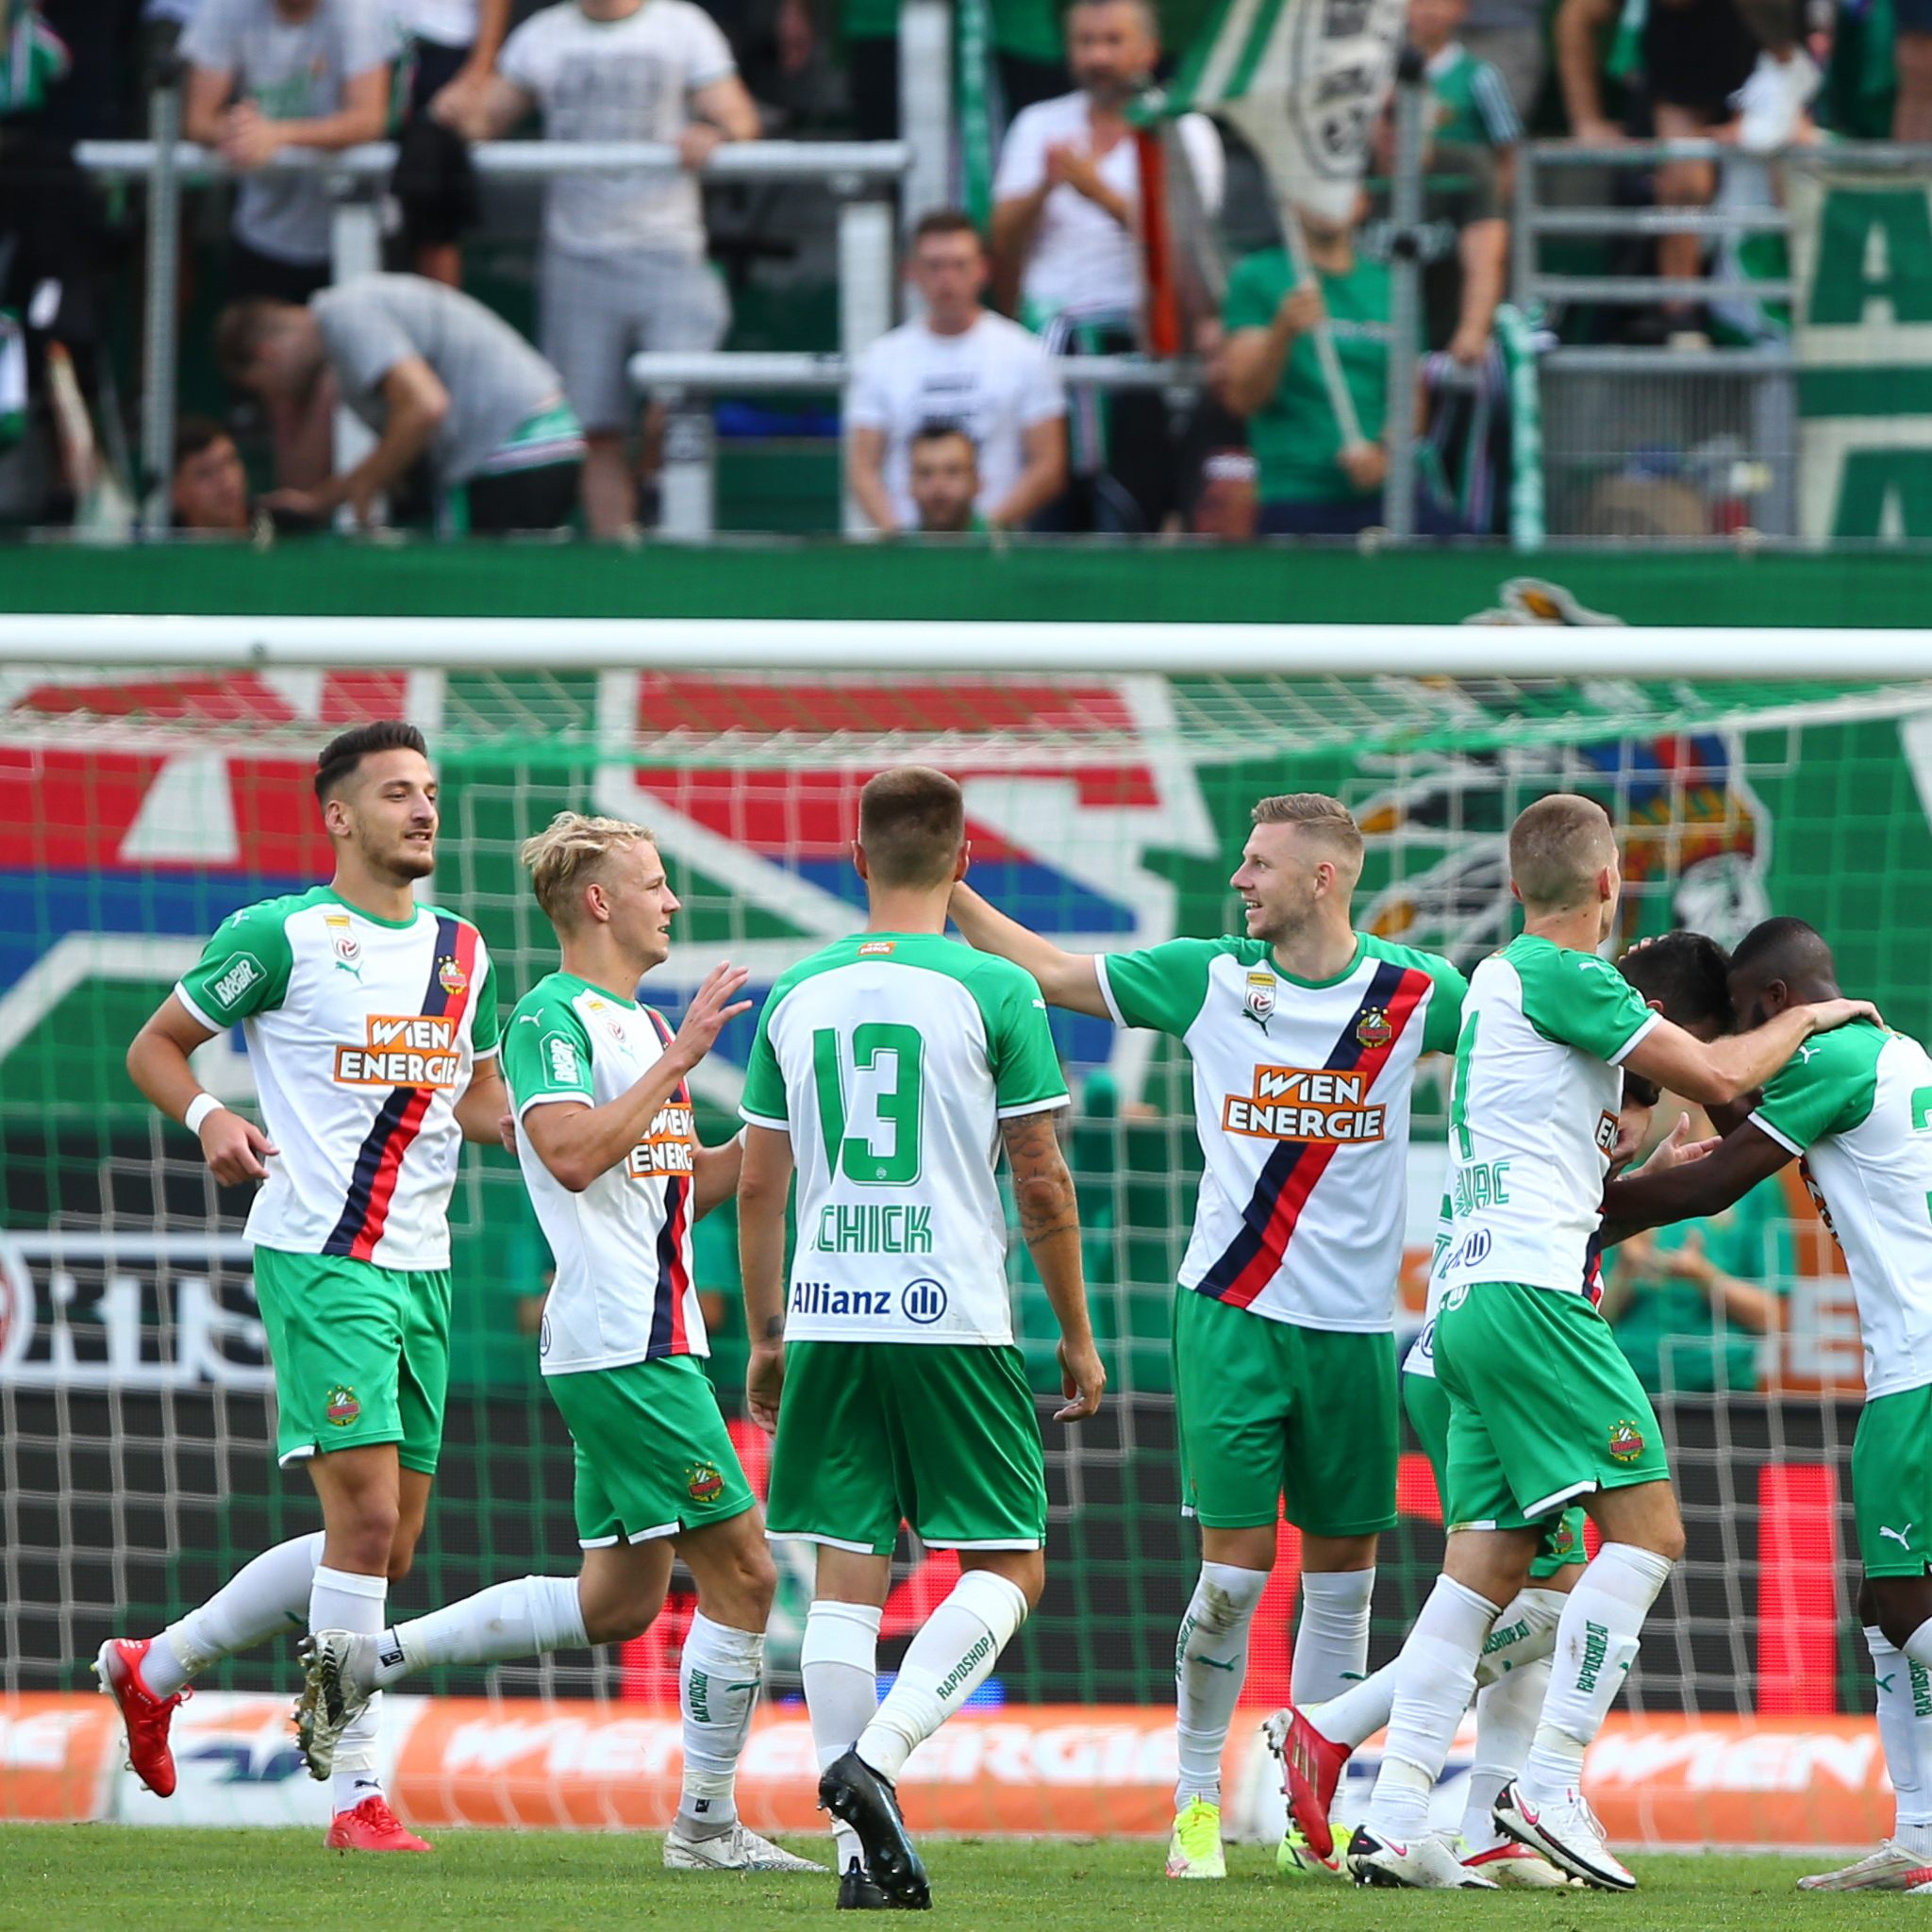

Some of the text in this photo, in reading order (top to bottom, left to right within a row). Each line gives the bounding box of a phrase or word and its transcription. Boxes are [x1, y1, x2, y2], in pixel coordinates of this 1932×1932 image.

[372, 1019, 451, 1050] WIEN
[1258, 1071, 1361, 1105] WIEN
[1227, 1099, 1382, 1139] ENERGIE
[810, 1205, 933, 1254] CHICK
[791, 1281, 892, 1316] Allianz
[1585, 1732, 1876, 1790] WIEN
